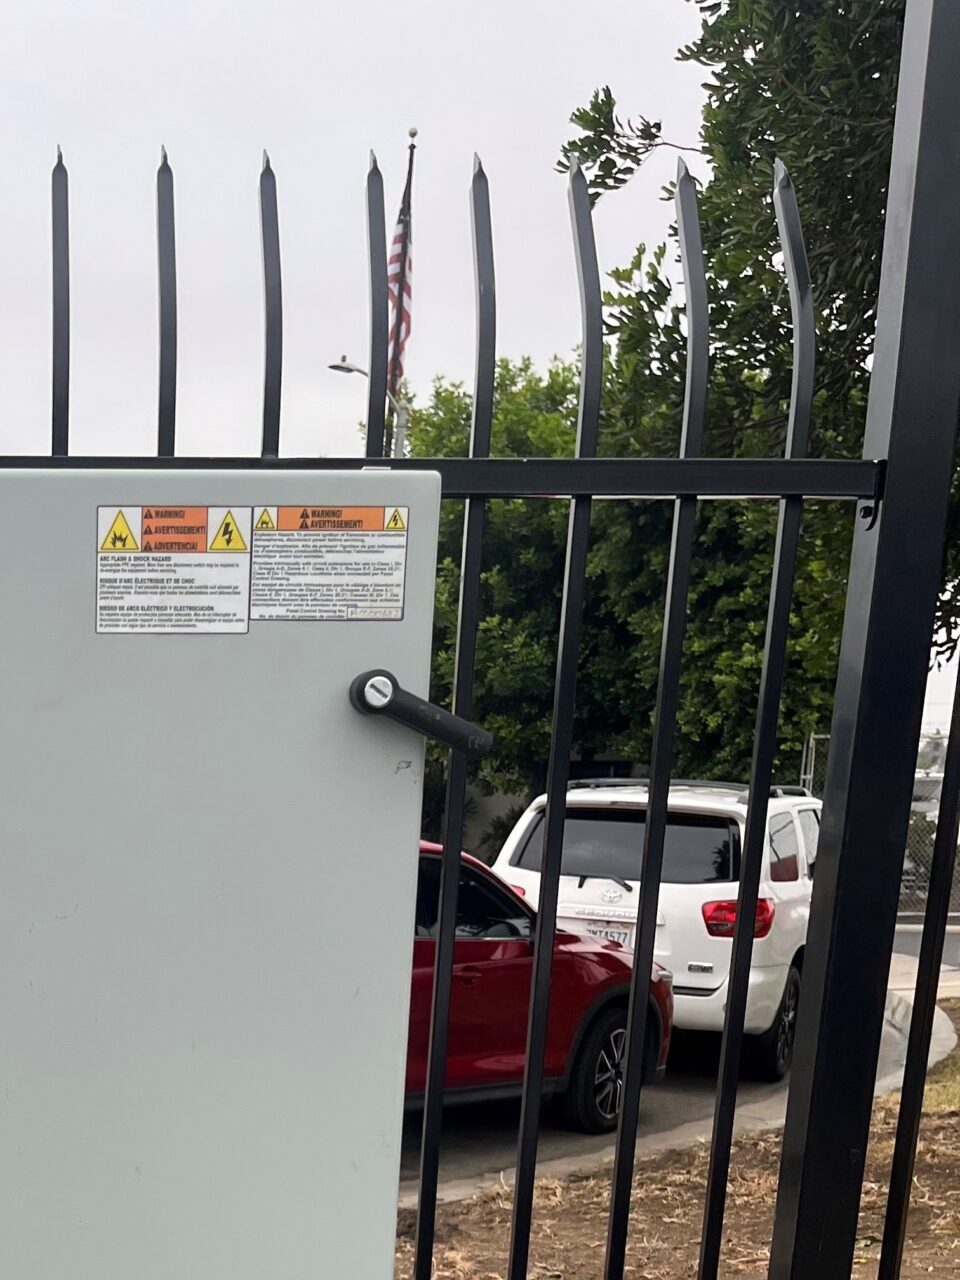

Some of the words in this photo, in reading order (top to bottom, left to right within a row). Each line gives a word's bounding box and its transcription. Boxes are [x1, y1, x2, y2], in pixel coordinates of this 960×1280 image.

[154, 510, 185, 519] WARNING!
[310, 509, 343, 518] WARNING!
[310, 519, 364, 529] AVERTISSEMENT!
